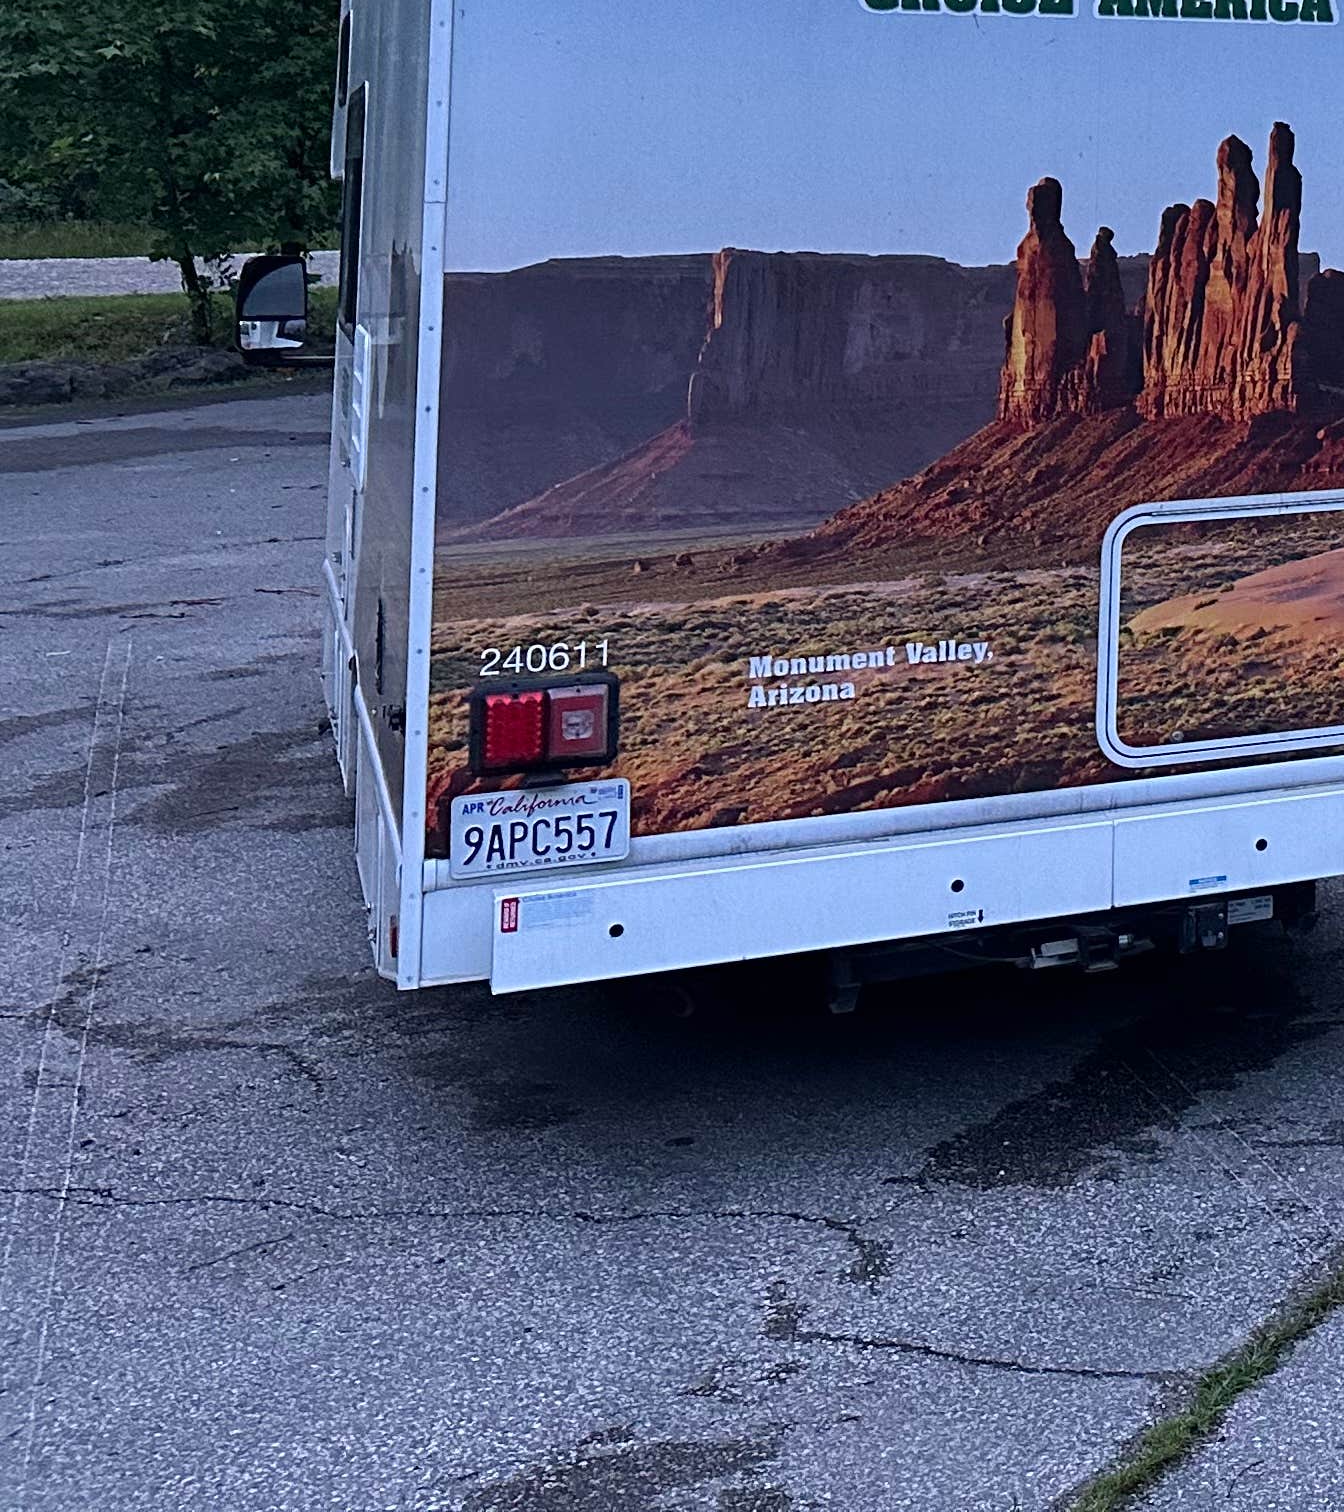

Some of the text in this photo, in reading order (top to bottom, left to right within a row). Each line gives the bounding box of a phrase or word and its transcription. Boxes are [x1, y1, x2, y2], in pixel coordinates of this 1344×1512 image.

[479, 638, 609, 677] 240611
[748, 639, 994, 678] Monument Valley,
[747, 682, 855, 708] Arizona
[462, 794, 598, 818] APR California
[463, 810, 618, 866] 9APC557
[496, 853, 587, 870] dmv.ca.gov
